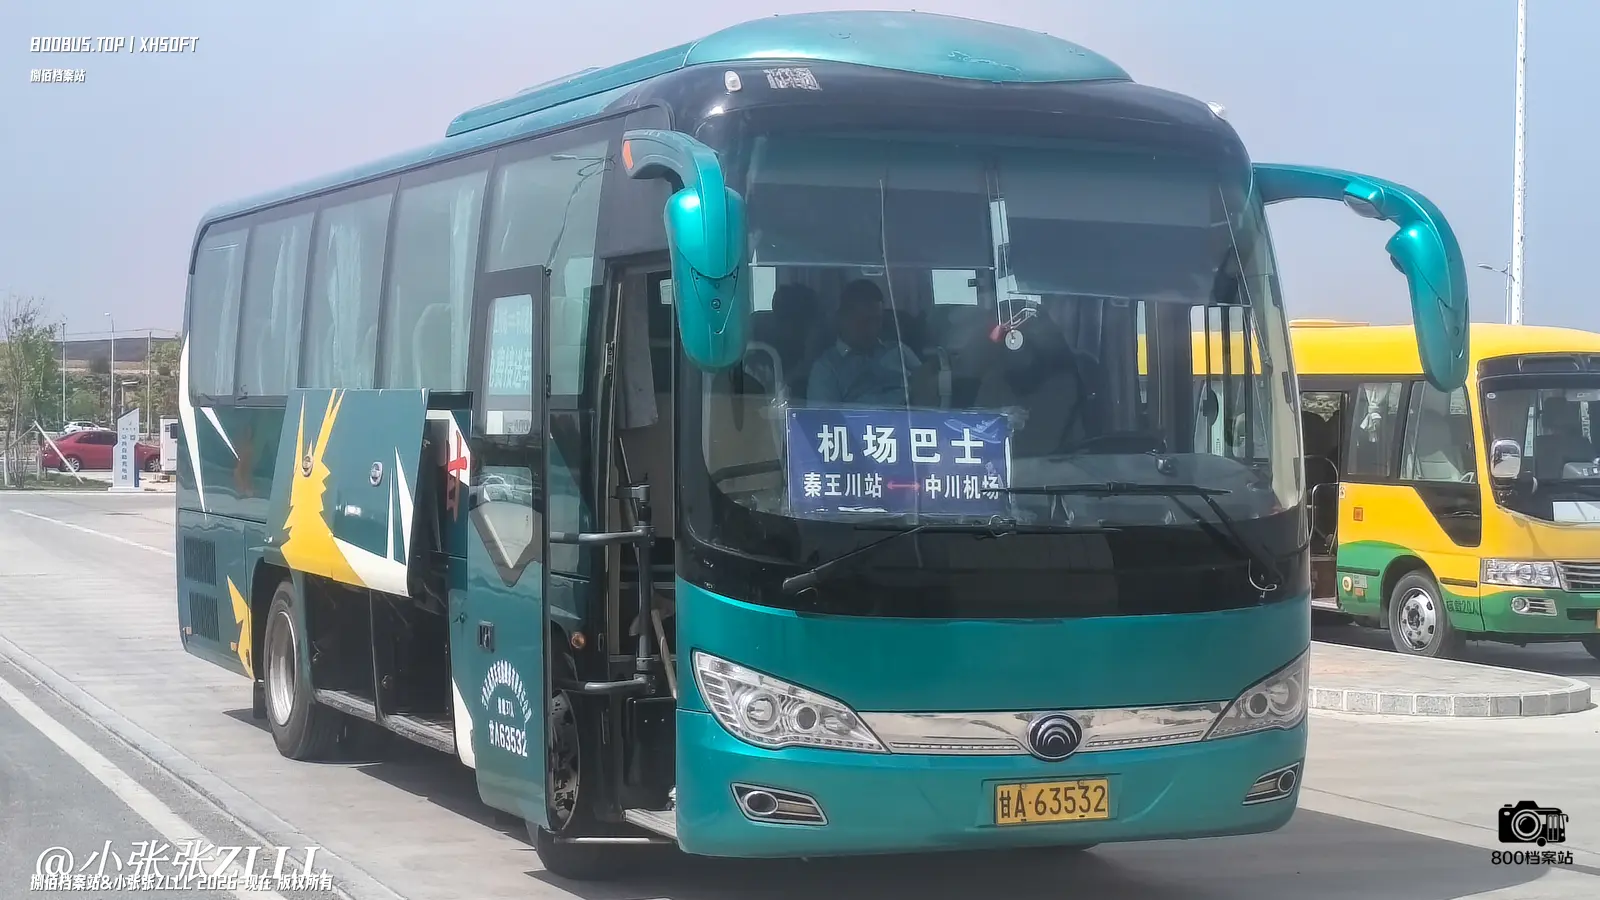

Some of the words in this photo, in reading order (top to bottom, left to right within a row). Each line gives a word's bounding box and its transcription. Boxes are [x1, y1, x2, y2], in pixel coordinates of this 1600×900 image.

[817, 424, 984, 464] 机场巴士
[803, 471, 883, 498] 秦王川站
[925, 473, 1000, 500] 中川机场
